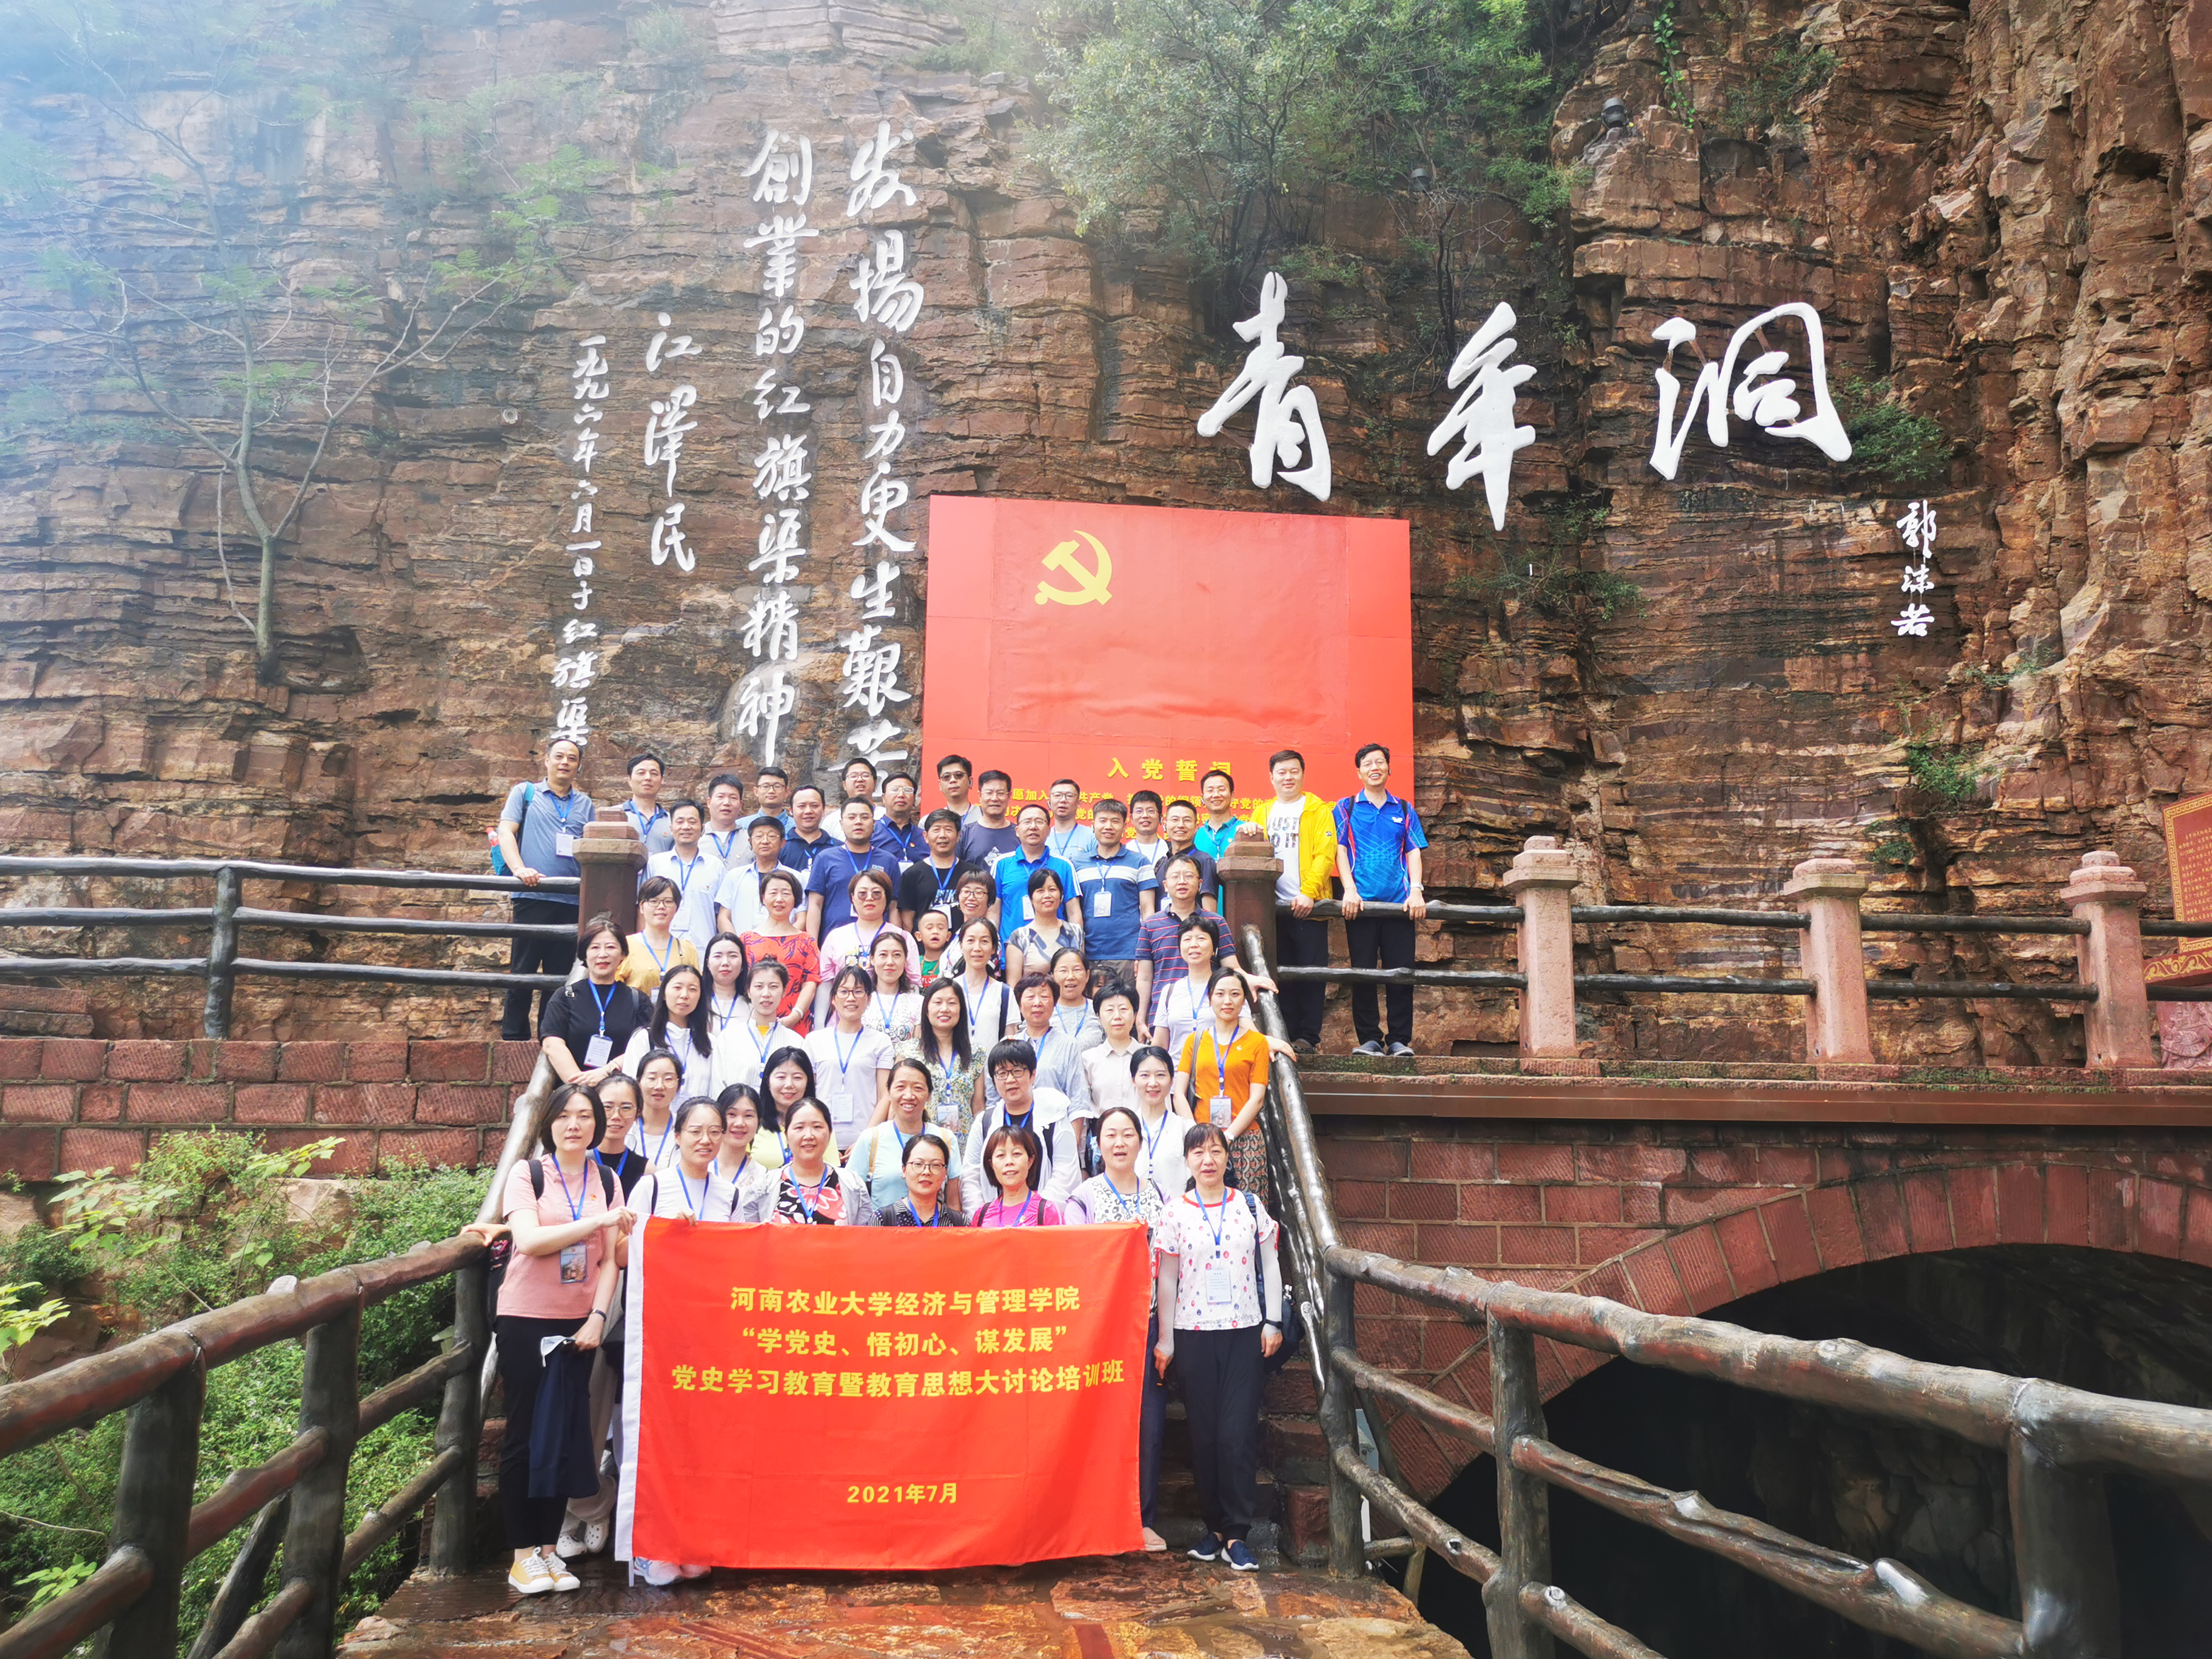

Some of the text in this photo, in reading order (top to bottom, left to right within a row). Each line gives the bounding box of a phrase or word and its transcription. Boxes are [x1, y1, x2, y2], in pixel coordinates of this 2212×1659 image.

[1196, 271, 1852, 531] 青年洞
[730, 1286, 1081, 1317] 河南农业大学经济与管理学院
[671, 1359, 1125, 1398] 党史学习教育暨教育思想大讨论培训班
[846, 1483, 958, 1504] 2021年7月
